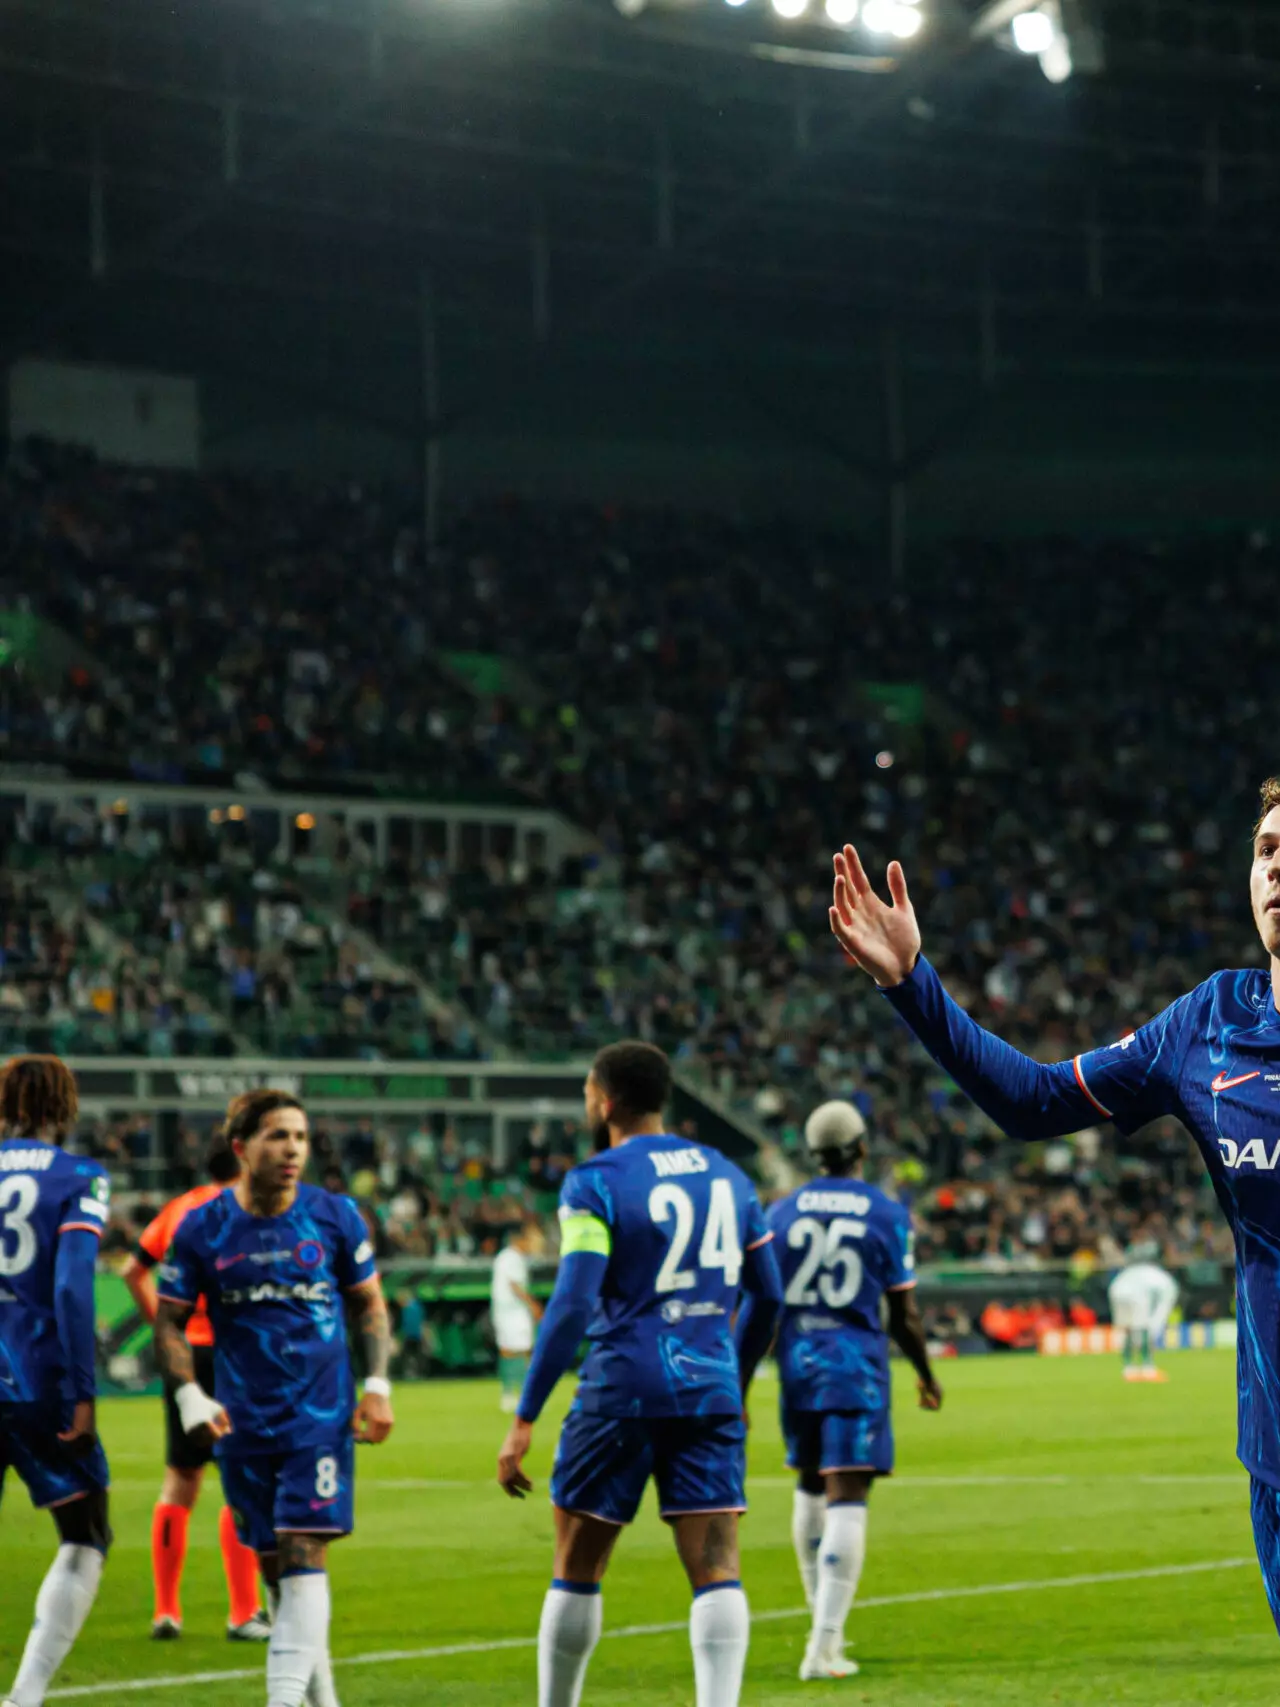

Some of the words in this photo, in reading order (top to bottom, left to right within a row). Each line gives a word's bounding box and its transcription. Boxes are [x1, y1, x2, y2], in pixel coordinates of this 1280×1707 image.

[648, 1148, 709, 1177] JAMES
[648, 1178, 744, 1293] 24
[785, 1217, 867, 1308] 25
[316, 1457, 338, 1498] 8
